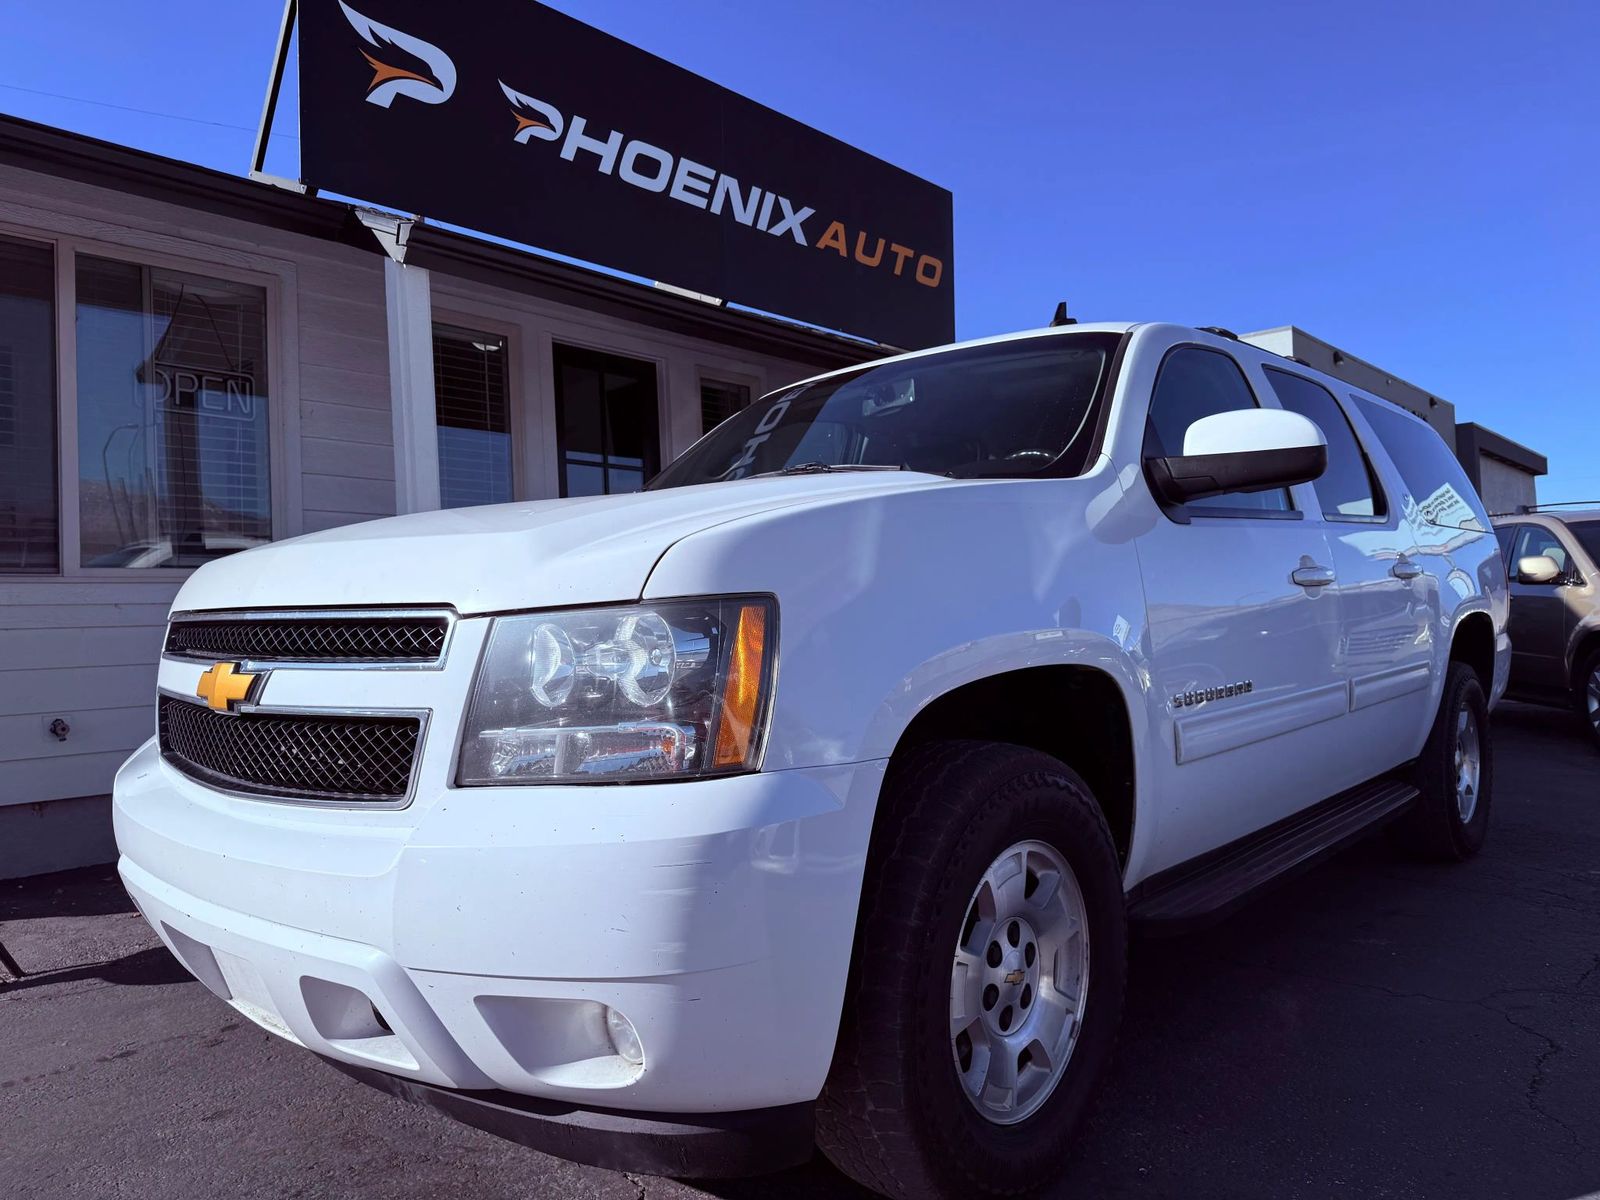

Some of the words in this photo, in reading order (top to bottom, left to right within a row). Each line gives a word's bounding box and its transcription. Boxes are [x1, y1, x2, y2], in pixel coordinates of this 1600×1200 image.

[498, 78, 816, 247] PHOENIX
[815, 220, 943, 289] AUTO
[150, 367, 251, 414] OPEN
